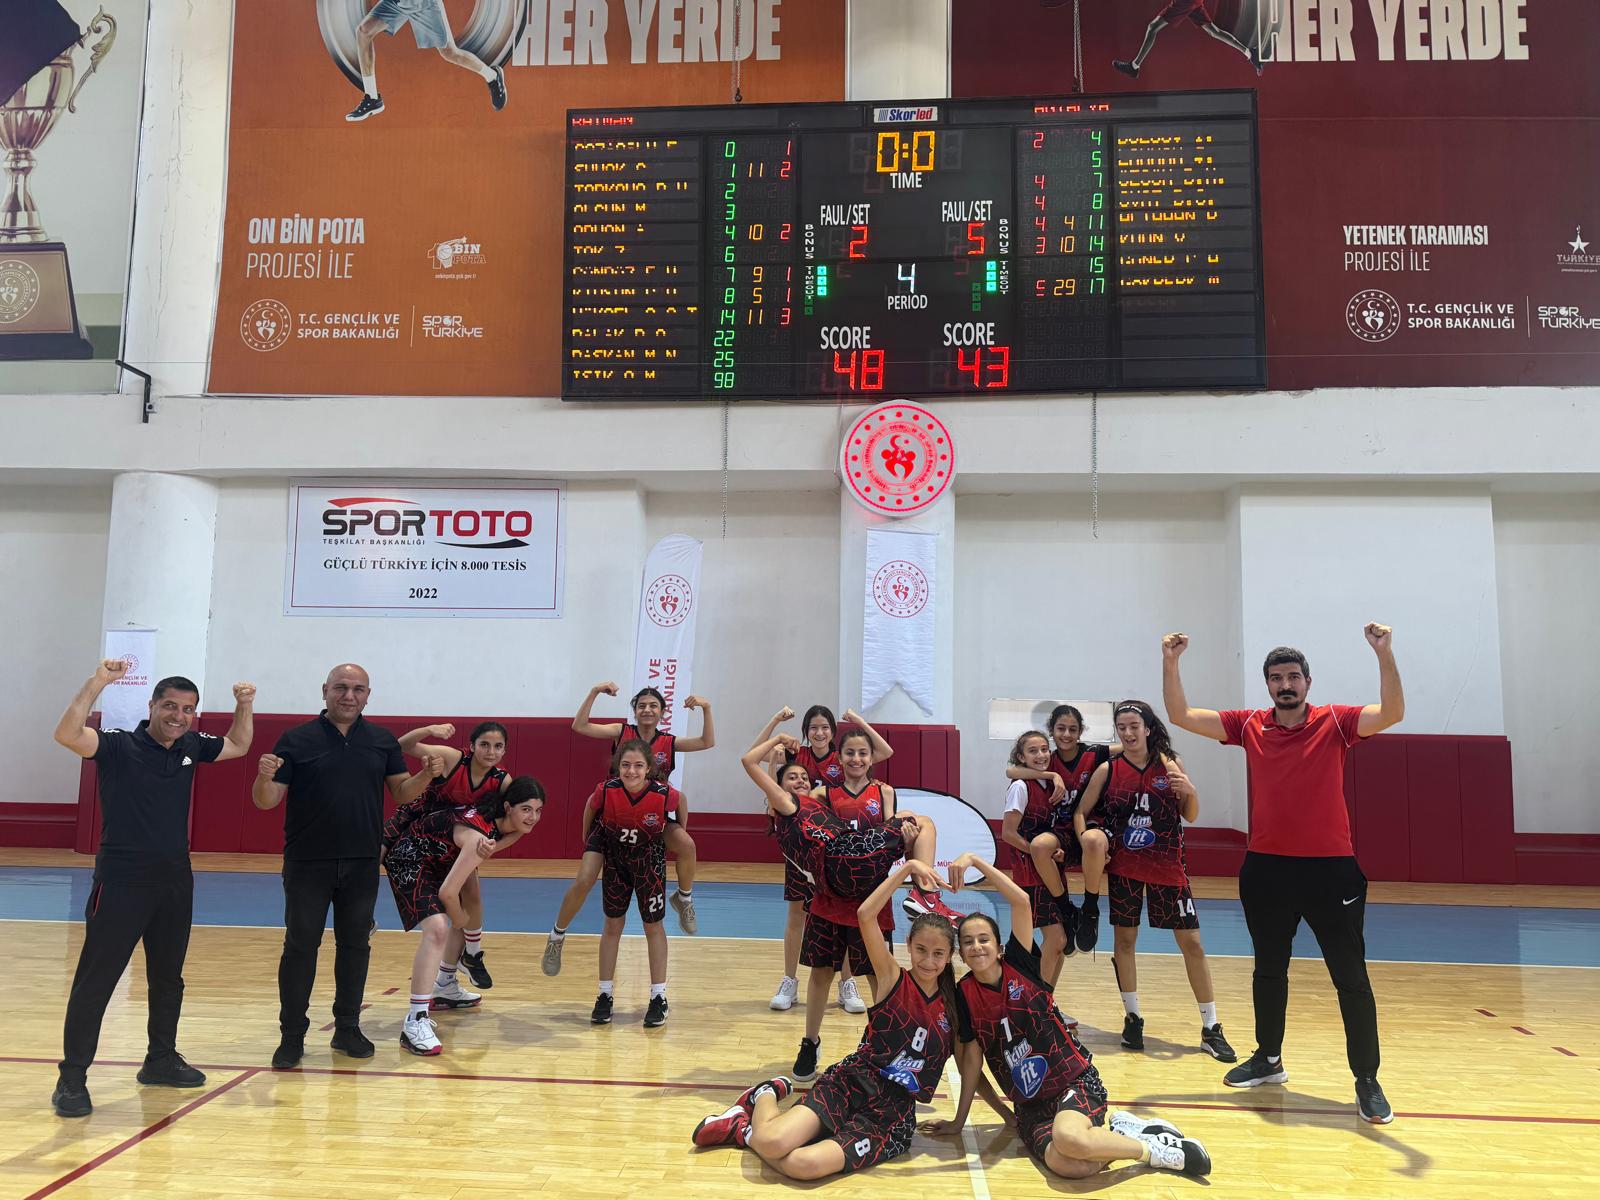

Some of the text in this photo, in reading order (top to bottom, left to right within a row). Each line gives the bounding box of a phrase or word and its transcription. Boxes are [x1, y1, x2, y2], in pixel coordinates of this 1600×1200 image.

[512, 0, 781, 65] HER YERDE
[1258, 0, 1529, 62] HER YERDE
[889, 107, 933, 122] Skorled
[1033, 132, 1044, 148] 2
[1091, 131, 1101, 145] 4
[725, 141, 735, 157] 0
[876, 131, 935, 173] 0:0
[1092, 151, 1101, 168] 5
[780, 161, 791, 177] 2
[890, 172, 923, 188] TIME
[1034, 175, 1045, 190] 4
[1094, 172, 1102, 188] 7
[725, 183, 736, 199] 2
[942, 200, 993, 222] FAUL/SET
[1035, 195, 1045, 211] 4
[1092, 193, 1103, 209] 8
[725, 204, 736, 220] 3
[820, 203, 871, 226] FAUL/SET
[249, 213, 365, 244] ON BİN POTA
[725, 223, 791, 240] 4 10 2
[1035, 216, 1046, 231] 4
[1064, 215, 1075, 231] 4
[804, 224, 814, 259] BONUS
[849, 224, 868, 258] 2
[967, 222, 985, 255] 5
[999, 218, 1009, 254] BONUS
[1035, 237, 1046, 254] 3
[1060, 235, 1075, 253] 10
[1089, 235, 1104, 252] 14
[1343, 225, 1489, 246] YETENEK TARAMASI
[725, 245, 735, 262] 6
[1344, 249, 1430, 272] PROJESİ İLE
[246, 249, 354, 279] PROJESİ İLE
[1089, 256, 1104, 273] 15
[727, 267, 735, 282] 7
[753, 266, 763, 282] 9
[898, 262, 916, 294] 4
[724, 287, 735, 303] 8
[753, 287, 762, 304] 5
[1053, 278, 1076, 296] 29
[1090, 278, 1105, 294] 17
[887, 294, 928, 310] PERIOD
[1407, 301, 1514, 316] T.C. GENÇLİK VE
[299, 312, 400, 326] T.C. GENÇLİK VE
[720, 309, 735, 325] 14
[781, 308, 791, 325] 3
[1408, 316, 1515, 329] SPOR BAKANLIĞI
[297, 327, 399, 339] SPOR BAKANLIĞI
[422, 324, 483, 338] TÜRKİYE
[714, 330, 735, 347] 22
[820, 326, 871, 350] SCORE
[943, 322, 995, 346] SCORE
[714, 351, 735, 367] 25
[957, 346, 1009, 388] 43
[834, 349, 885, 390] 48
[714, 372, 735, 388] 98
[323, 537, 425, 546] TEŞKİLAT BAŞKANLIĞI
[324, 557, 527, 572] GÜÇLÜ TÜRKİYE İÇİN 8.000 TESİS
[408, 588, 438, 599] 2022
[648, 659, 661, 679] VE
[660, 659, 677, 734] AKANLIĞI
[1134, 792, 1150, 811] 14
[619, 828, 638, 844] 25
[1128, 830, 1148, 846] fit
[649, 893, 664, 913] 25
[1177, 898, 1196, 917] 14
[1000, 1017, 1013, 1043] 1
[911, 1026, 928, 1053] 8
[1020, 1060, 1039, 1095] fit
[854, 1137, 871, 1158] 8
